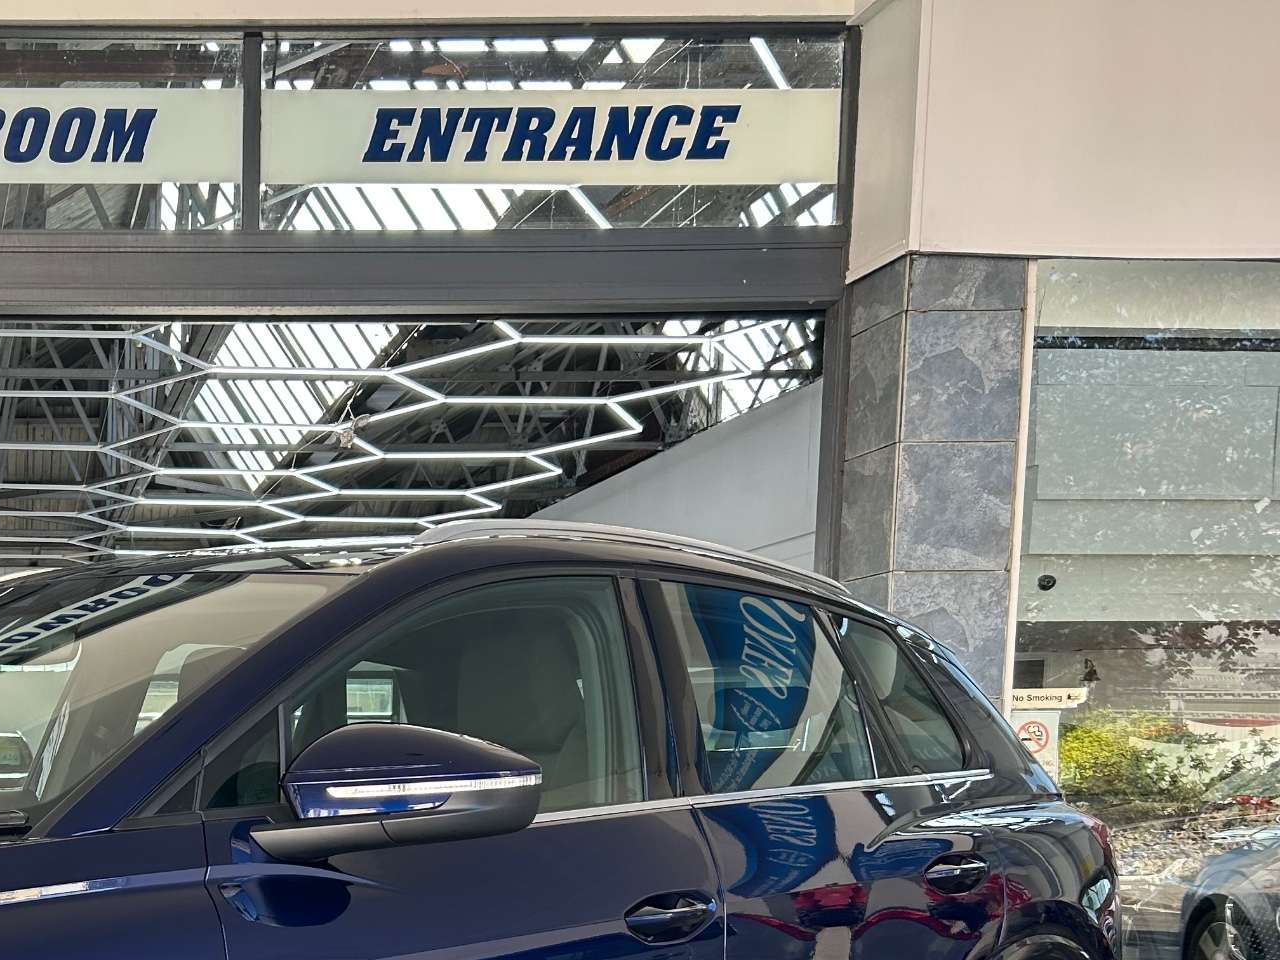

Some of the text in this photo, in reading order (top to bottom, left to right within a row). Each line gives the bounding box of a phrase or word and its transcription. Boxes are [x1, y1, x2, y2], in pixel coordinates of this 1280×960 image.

[361, 104, 742, 163] ENTRANCE
[1012, 694, 1063, 703] No Smoking
